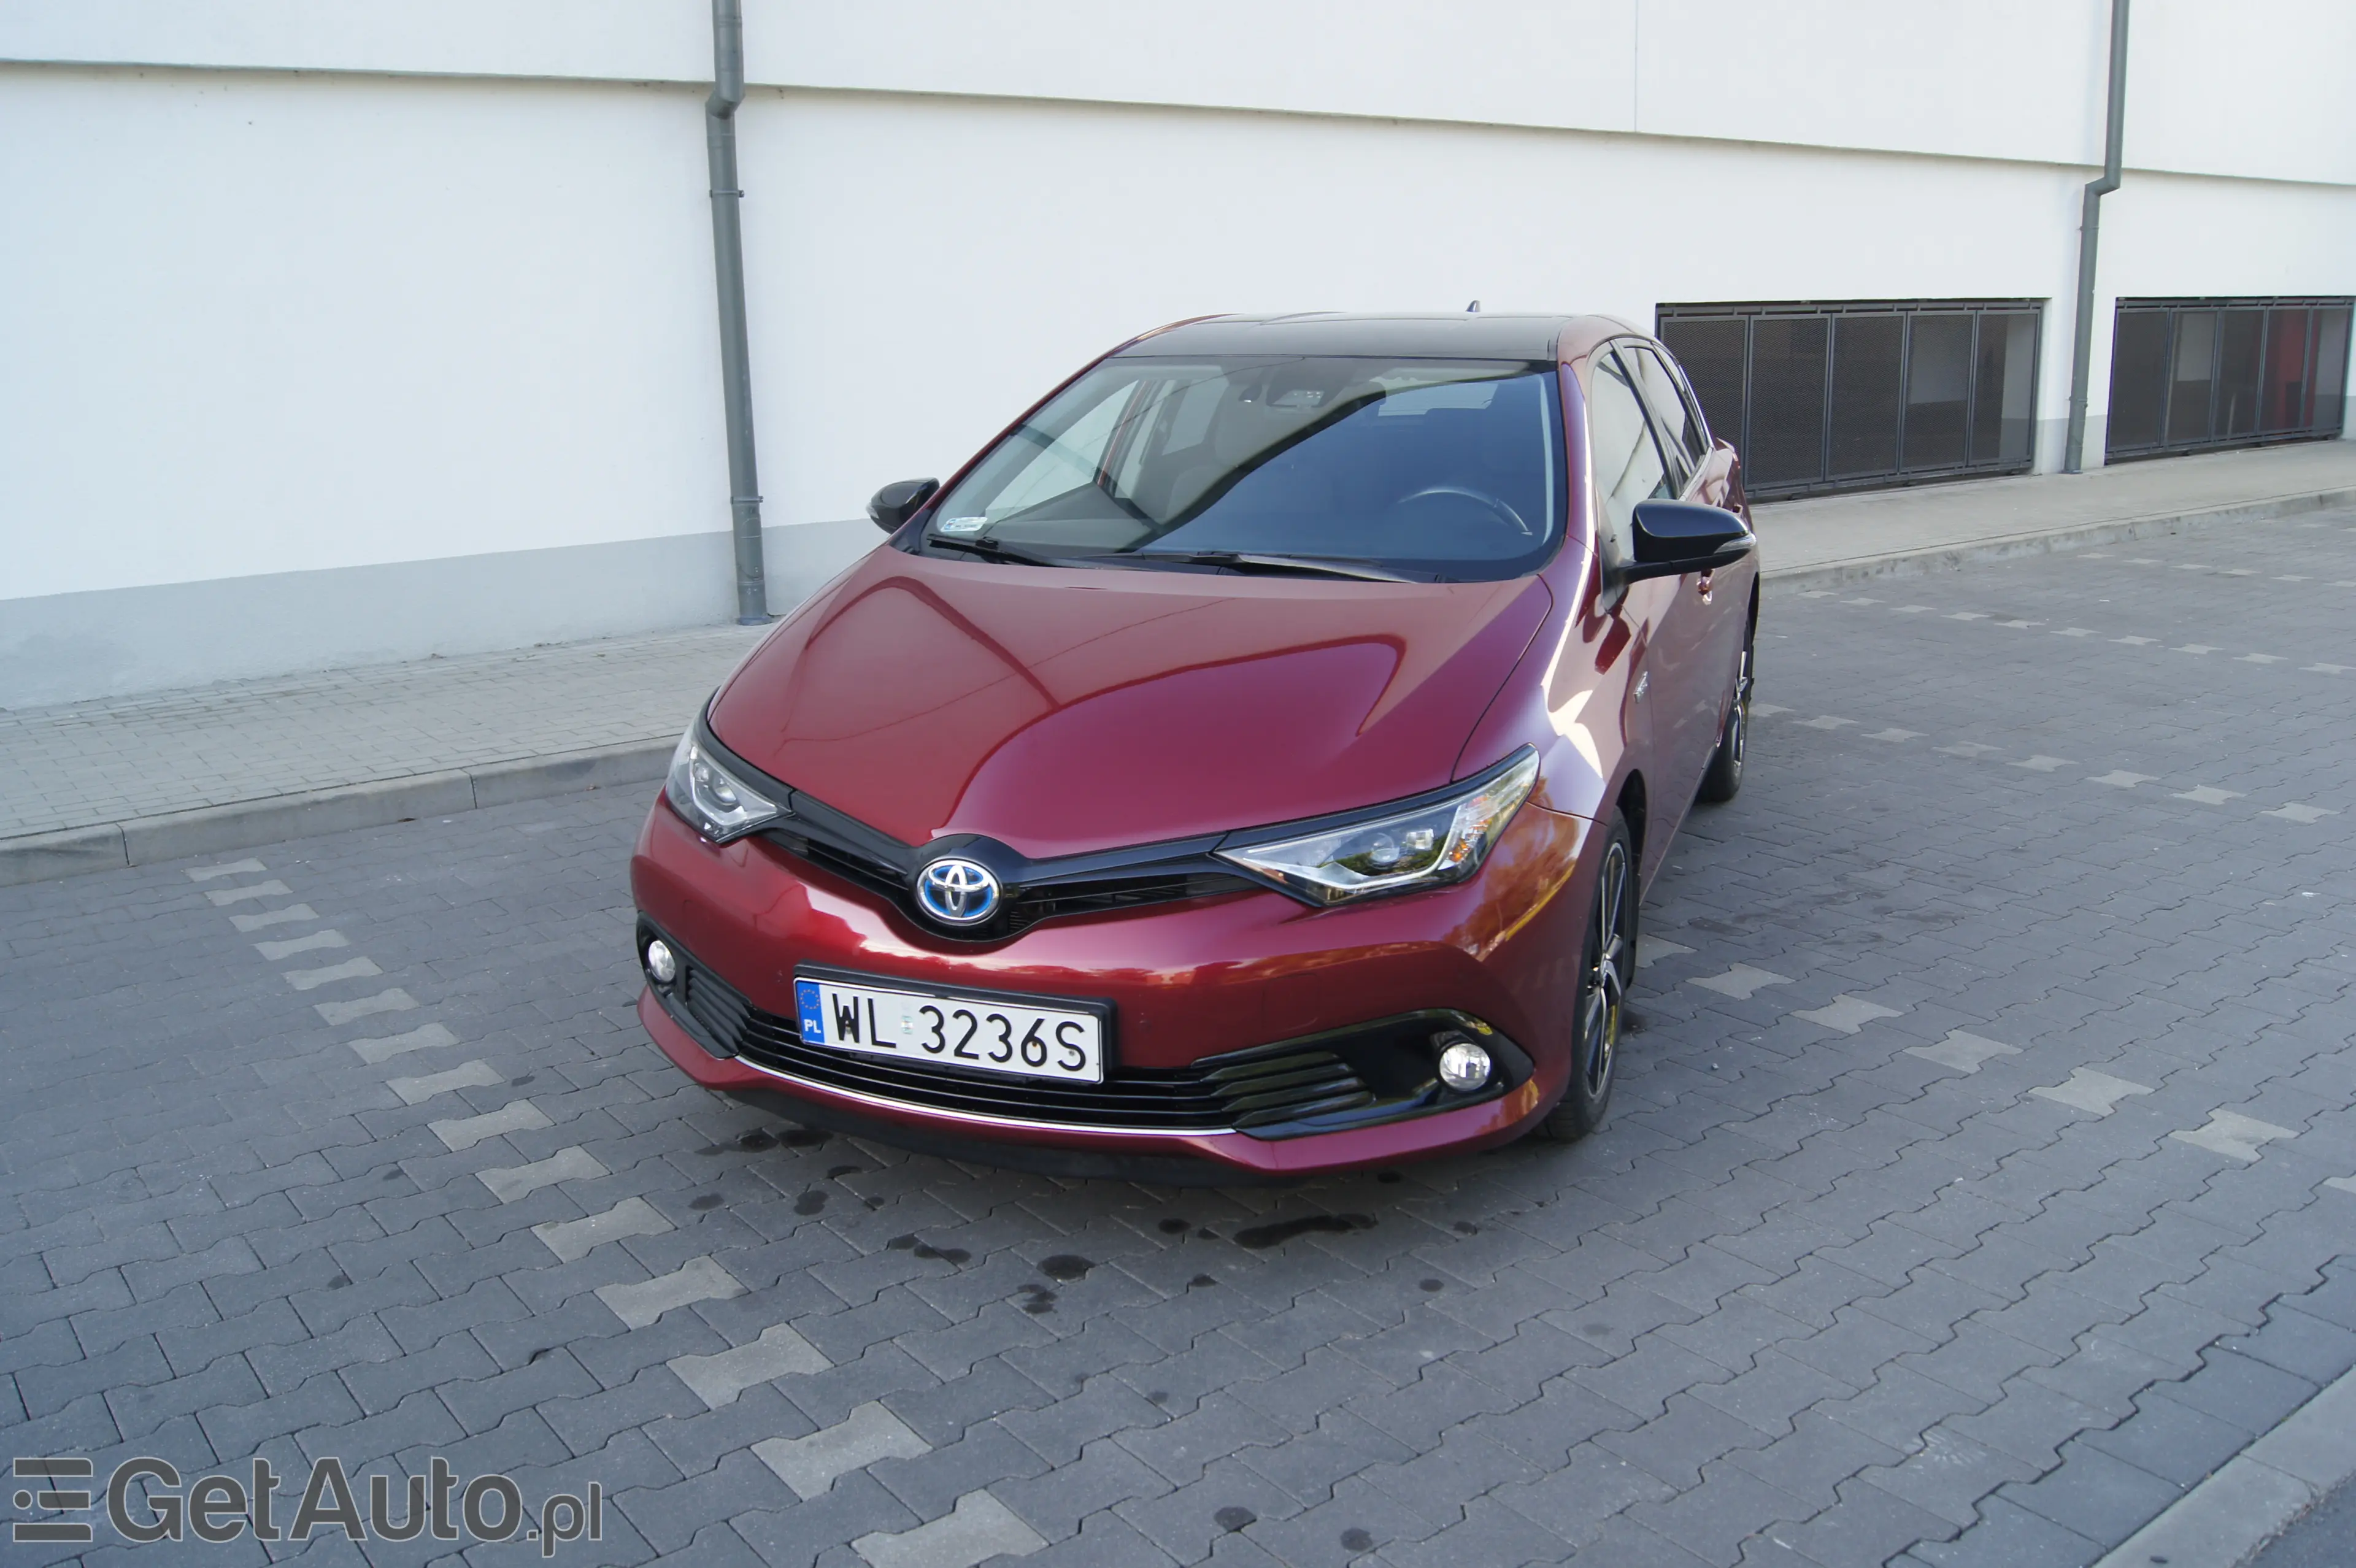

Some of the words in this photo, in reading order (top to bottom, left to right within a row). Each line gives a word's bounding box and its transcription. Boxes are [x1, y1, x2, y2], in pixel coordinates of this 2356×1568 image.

[804, 1019, 821, 1034] PL
[831, 993, 897, 1049] WL
[918, 1005, 1087, 1072] 3236S
